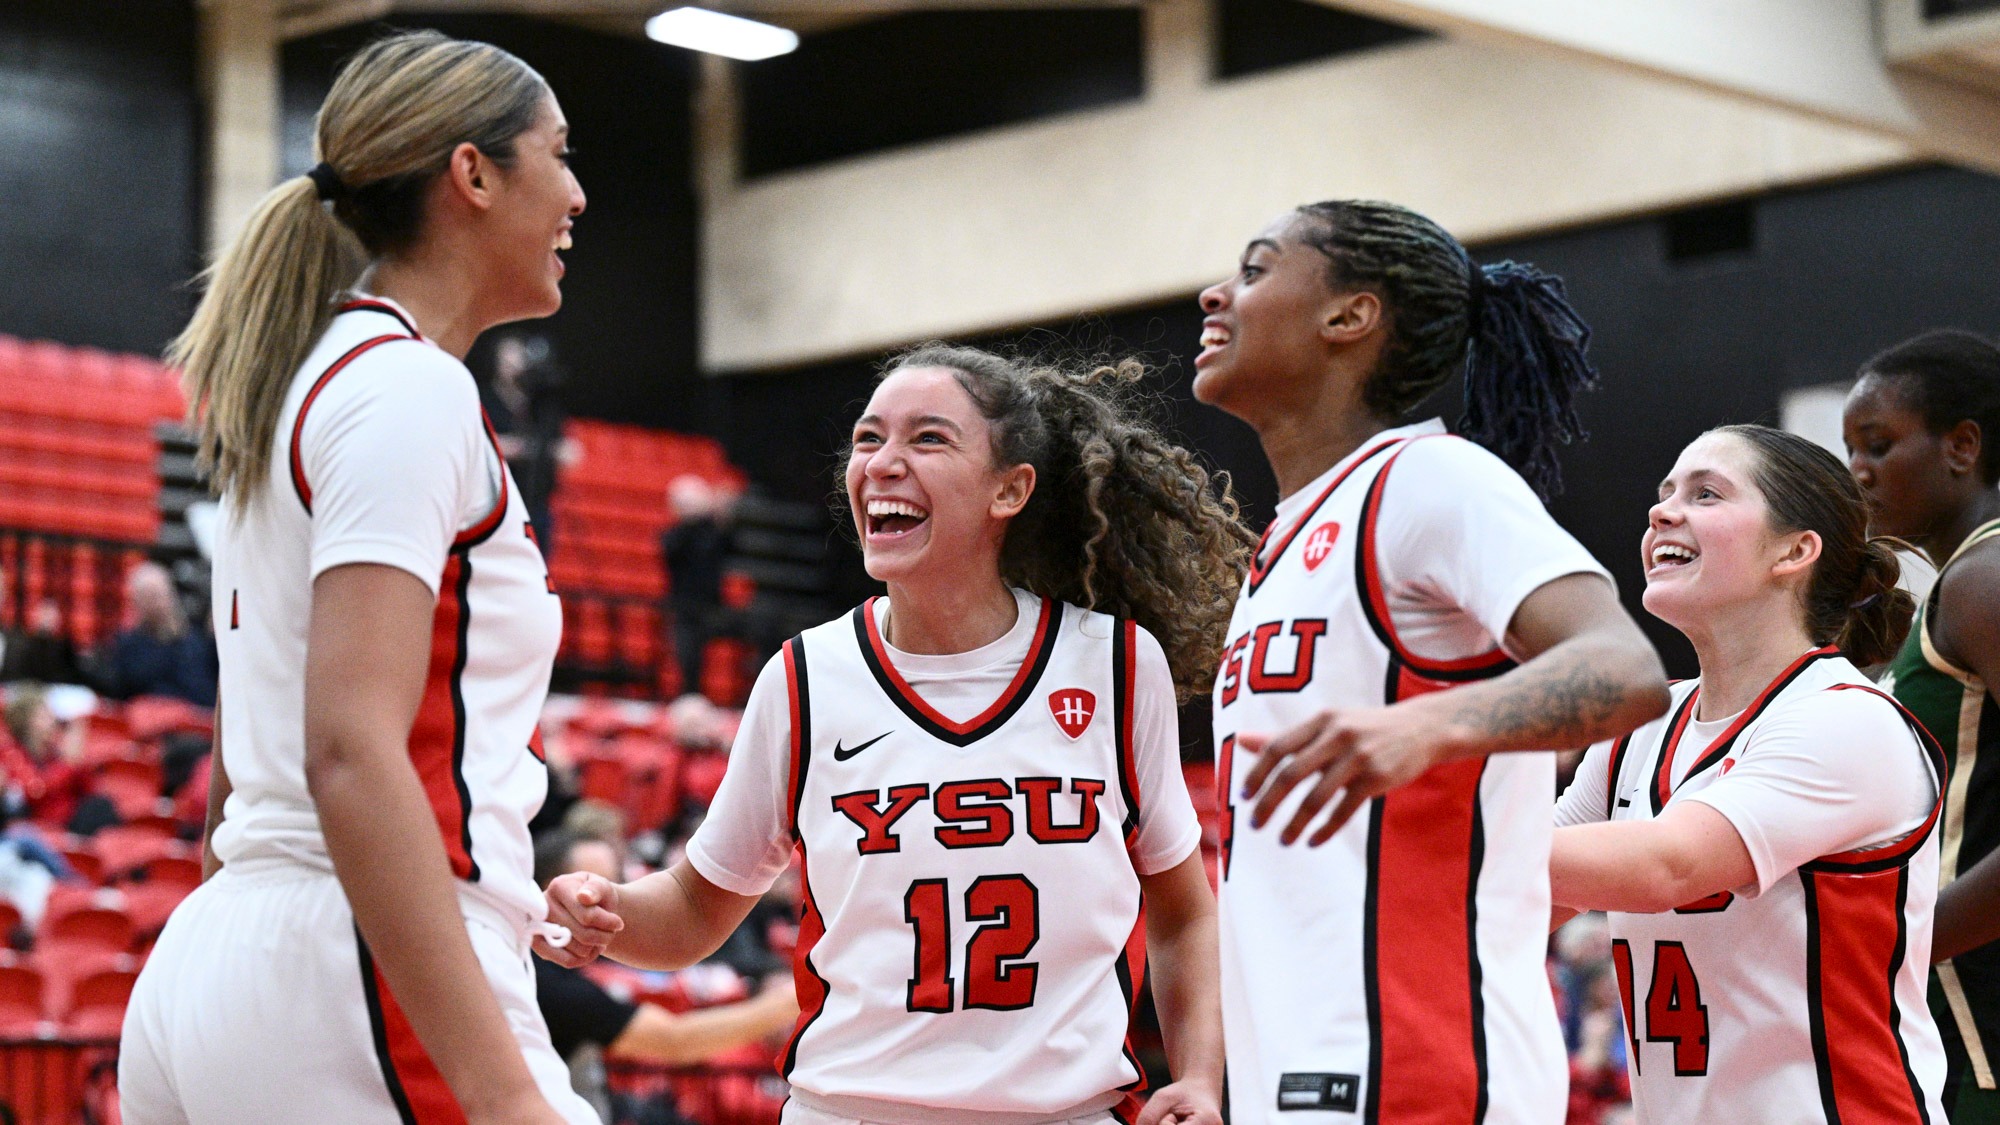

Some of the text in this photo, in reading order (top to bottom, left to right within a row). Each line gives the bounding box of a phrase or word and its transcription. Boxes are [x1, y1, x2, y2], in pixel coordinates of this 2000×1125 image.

[831, 777, 1106, 855] YSU
[904, 874, 1039, 1013] 12
[1331, 1082, 1348, 1100] M
